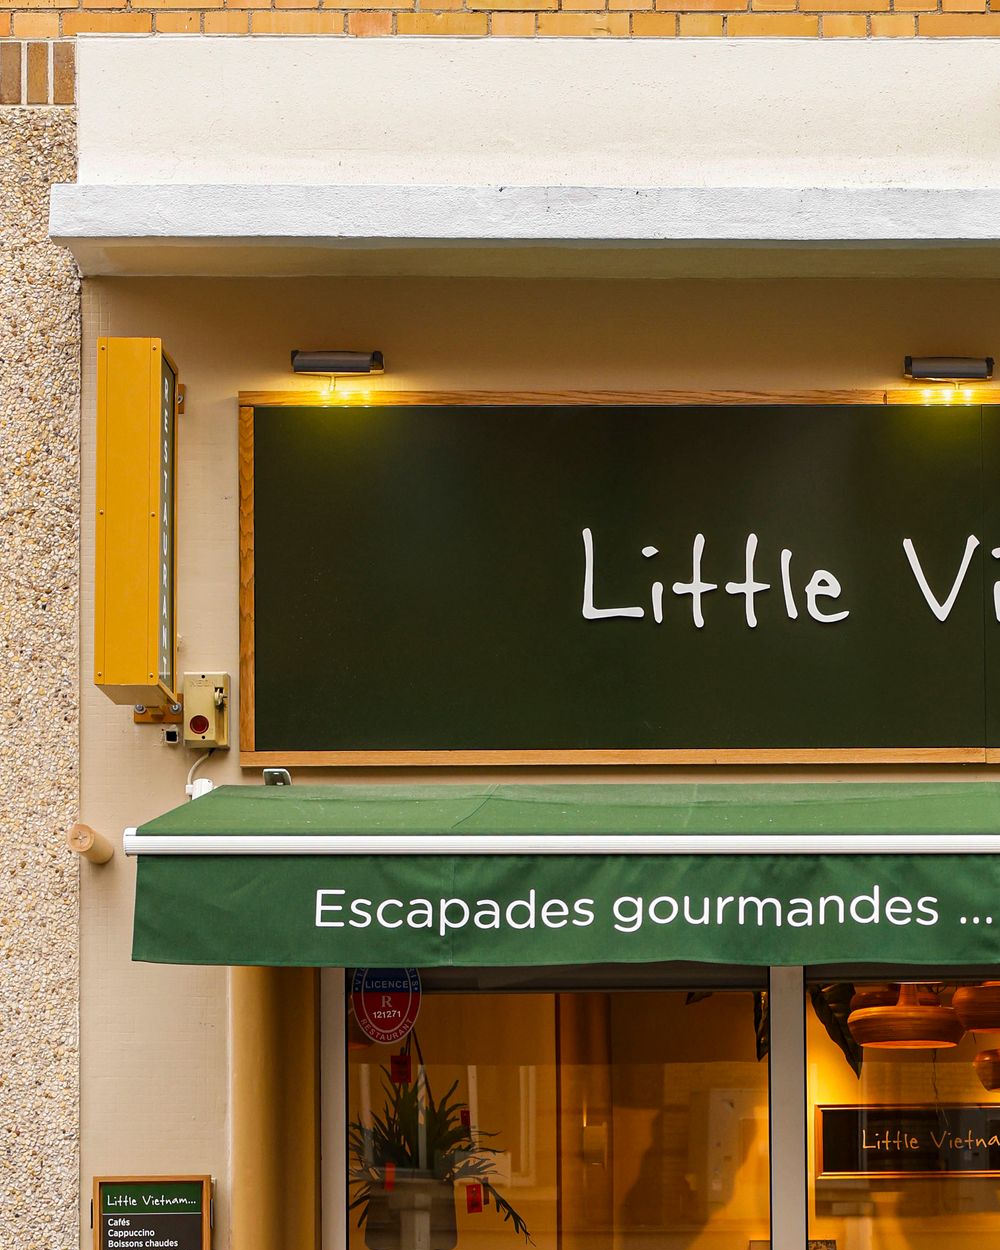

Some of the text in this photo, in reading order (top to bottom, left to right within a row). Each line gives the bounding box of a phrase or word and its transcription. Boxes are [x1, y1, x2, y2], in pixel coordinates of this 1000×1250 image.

[581, 526, 850, 629] Little
[314, 888, 595, 937] Escapades
[612, 884, 939, 934] gourmandes
[365, 980, 409, 989] LICENCE
[381, 995, 392, 1008] R
[373, 1009, 401, 1019] 121271
[361, 1018, 413, 1041] RESTAURANT
[861, 1129, 919, 1150] Little
[107, 1194, 196, 1207] Little Vietnam...
[107, 1218, 131, 1226] Cafés
[107, 1229, 155, 1238] Cappuccino
[108, 1239, 179, 1248] Boissons chaudes
